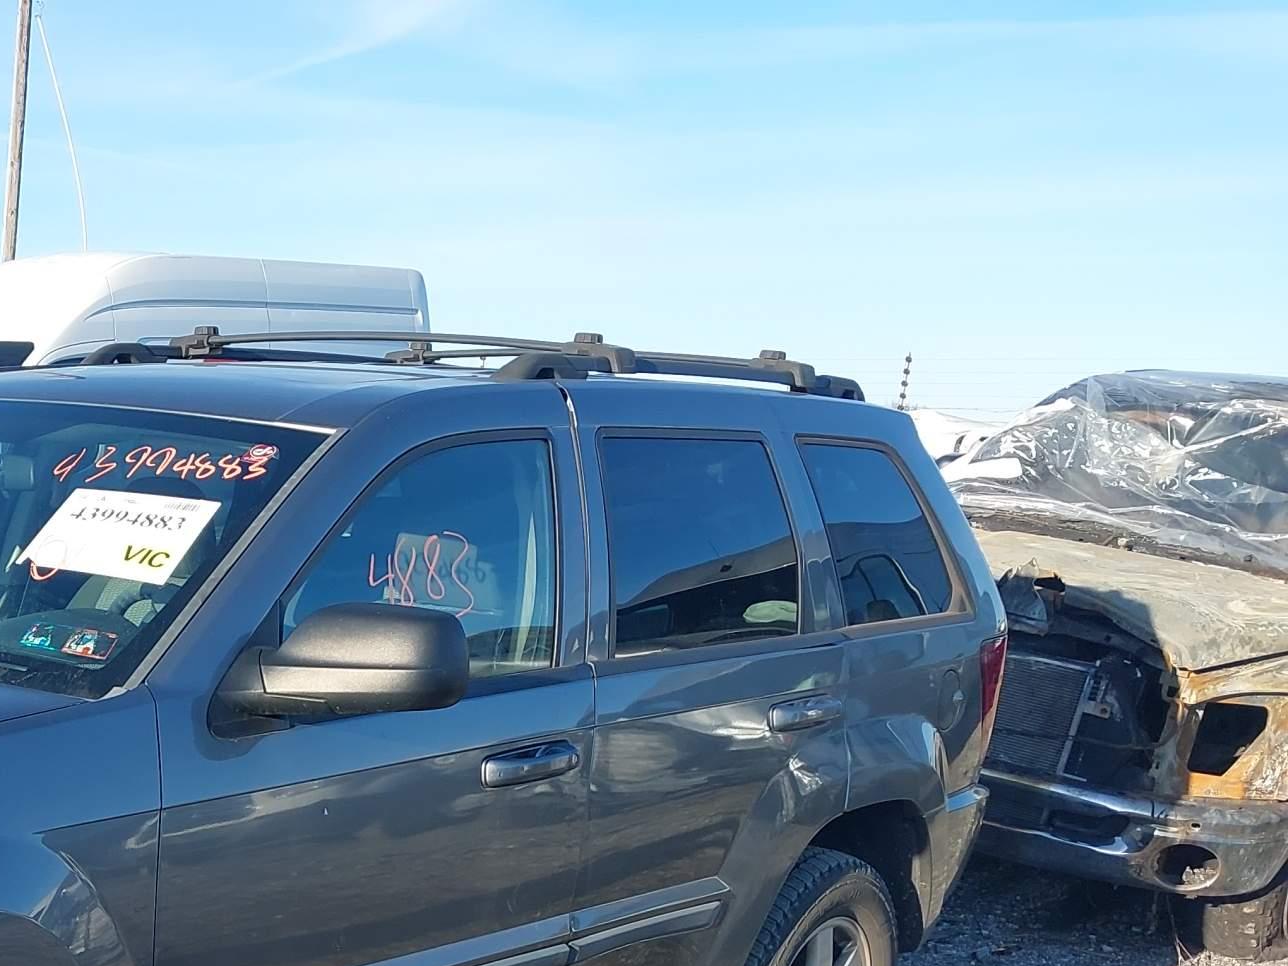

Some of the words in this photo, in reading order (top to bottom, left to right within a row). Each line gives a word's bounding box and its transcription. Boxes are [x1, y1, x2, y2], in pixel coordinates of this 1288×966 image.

[70, 506, 187, 531] 43994883
[124, 544, 171, 568] VIC
[368, 530, 475, 618] 4883
